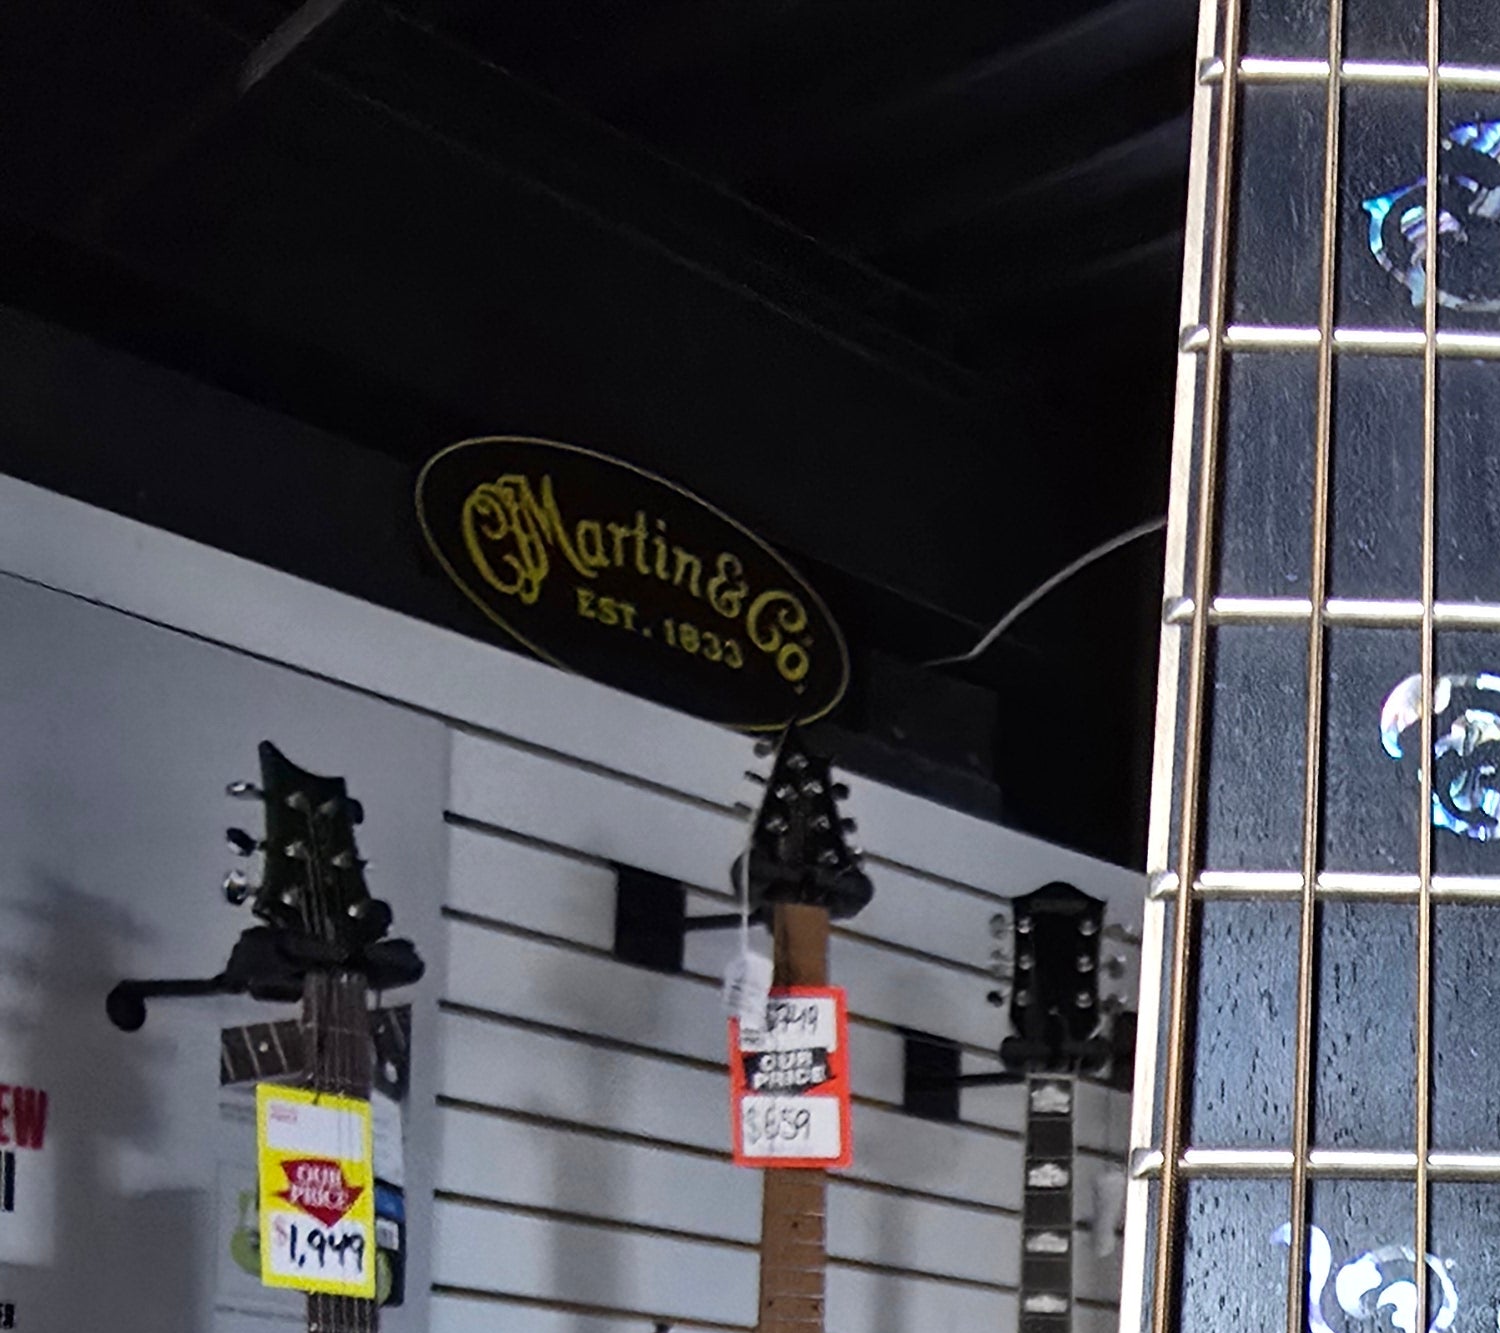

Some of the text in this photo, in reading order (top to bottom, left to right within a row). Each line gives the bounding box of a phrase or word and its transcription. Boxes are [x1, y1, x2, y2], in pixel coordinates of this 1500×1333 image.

[664, 618, 744, 670] 1833
[759, 1050, 813, 1073] OUR
[753, 1065, 827, 1089] PRICE
